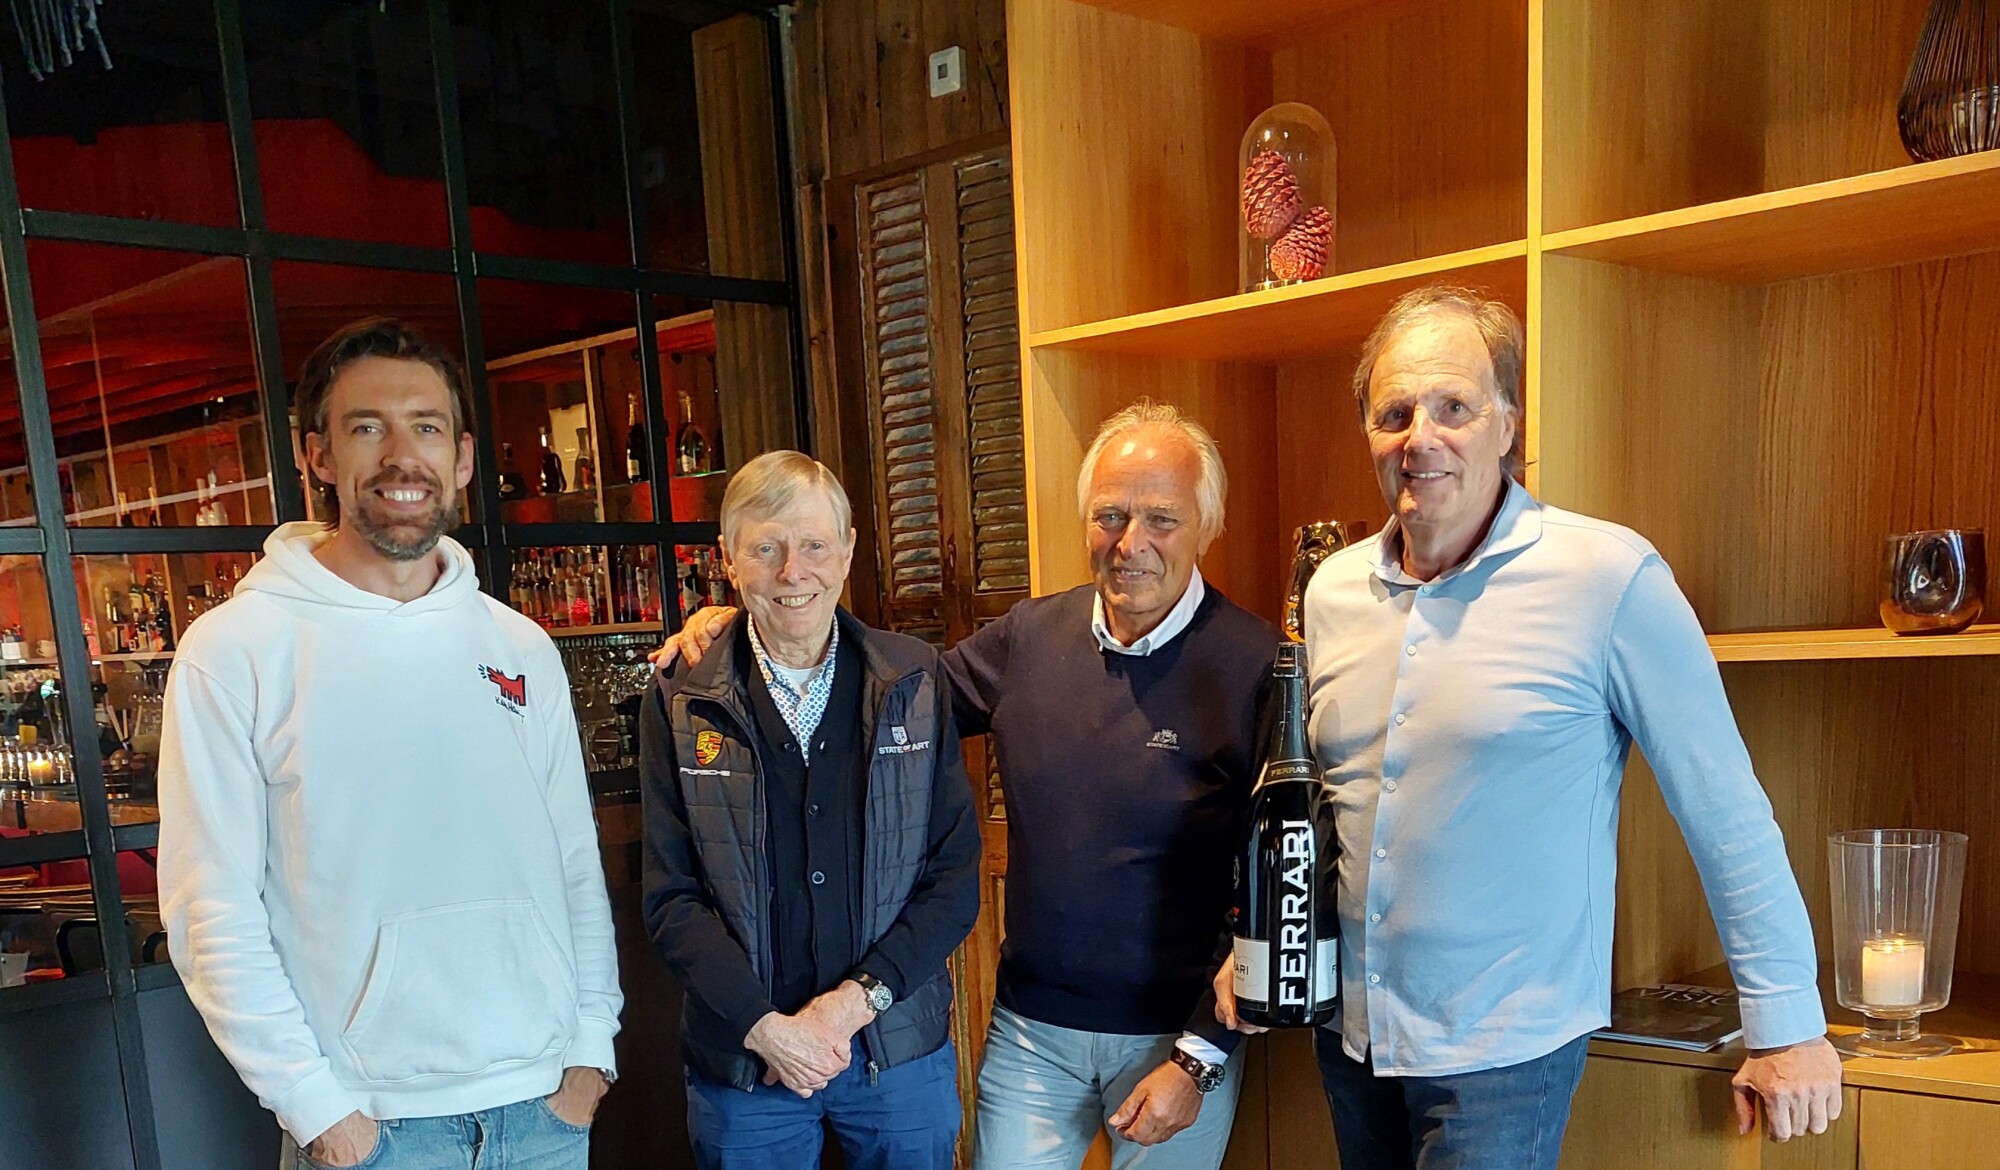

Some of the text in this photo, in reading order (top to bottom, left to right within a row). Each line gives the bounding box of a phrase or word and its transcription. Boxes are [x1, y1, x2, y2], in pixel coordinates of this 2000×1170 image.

[879, 746, 903, 754] STATE
[912, 741, 929, 751] ART
[680, 767, 730, 776] PORSCHE
[1271, 766, 1309, 777] FERRARI
[1279, 819, 1308, 1006] FERRARI
